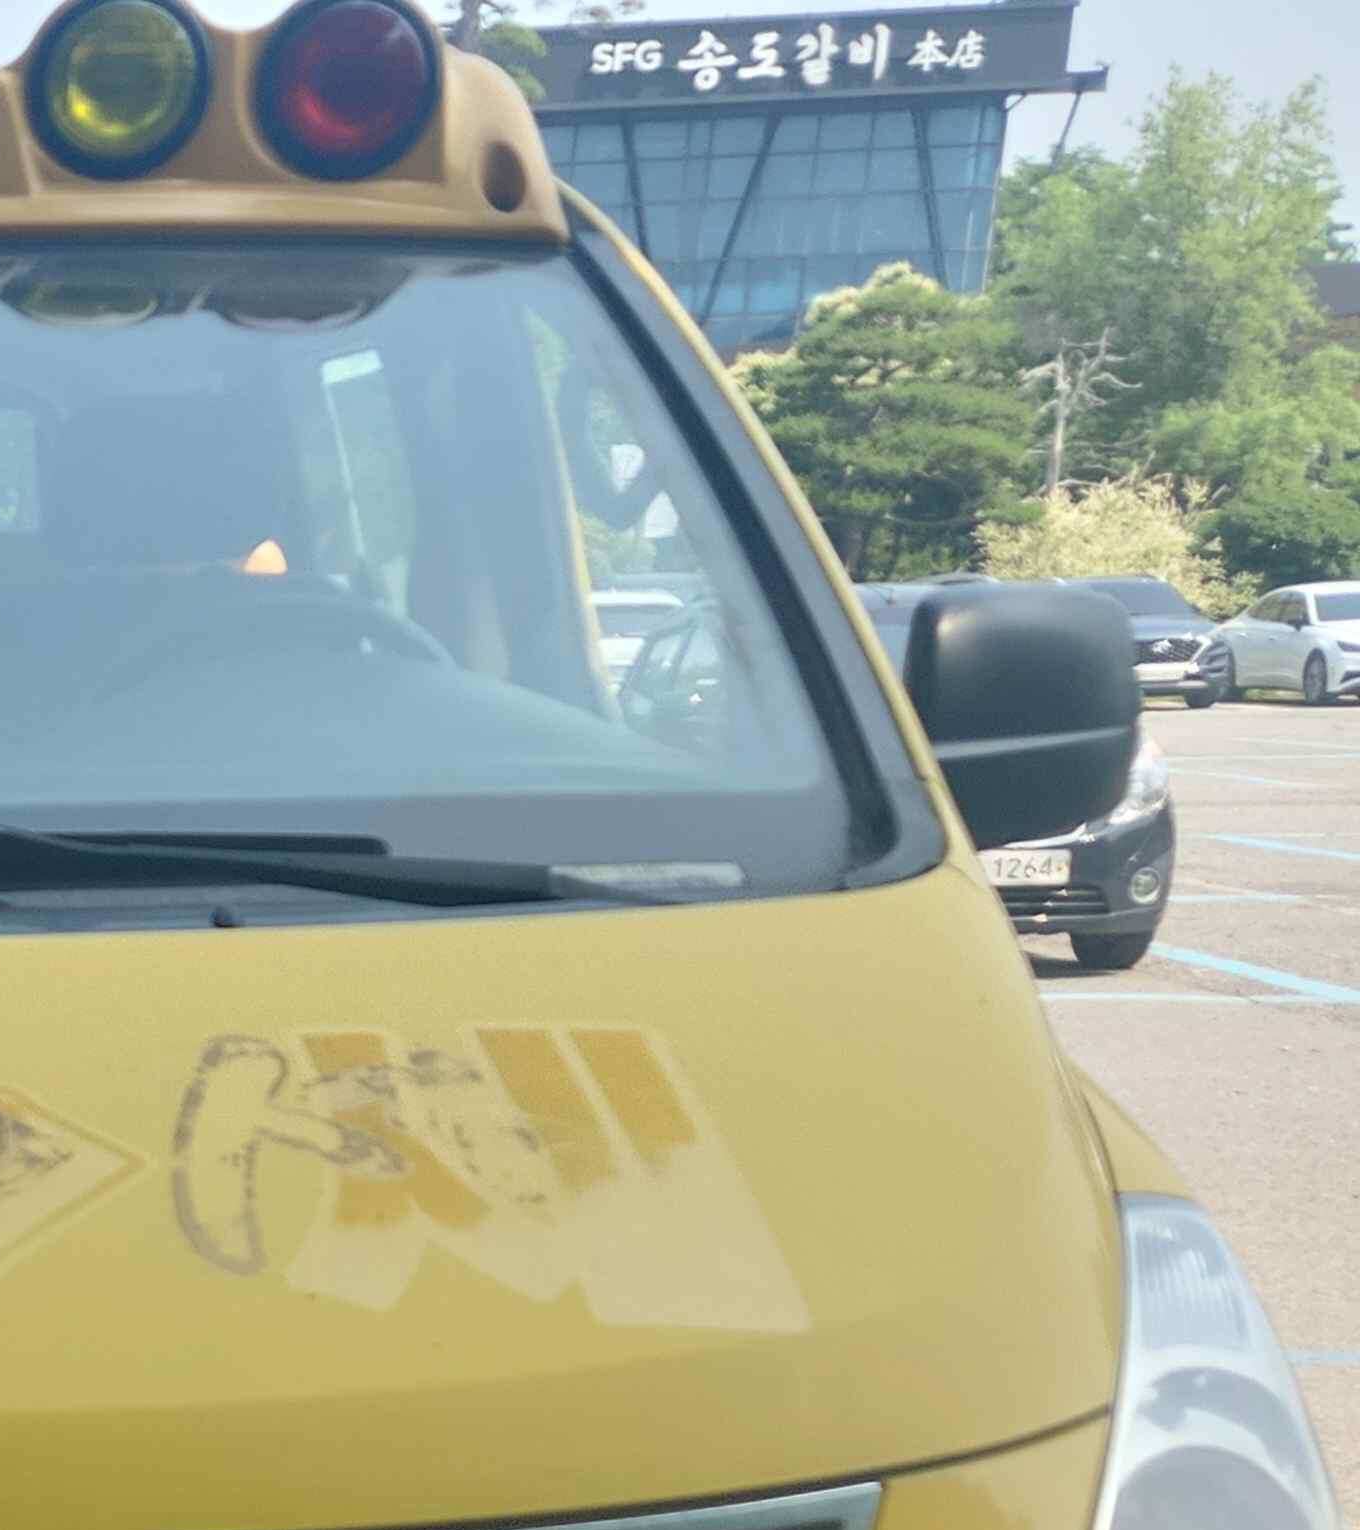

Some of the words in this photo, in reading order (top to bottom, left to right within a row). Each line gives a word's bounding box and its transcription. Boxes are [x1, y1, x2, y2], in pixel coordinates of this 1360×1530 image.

[591, 39, 663, 74] SFG
[678, 23, 892, 91] 송도갈비
[907, 29, 986, 71] 本店
[993, 855, 1053, 879] 1264
